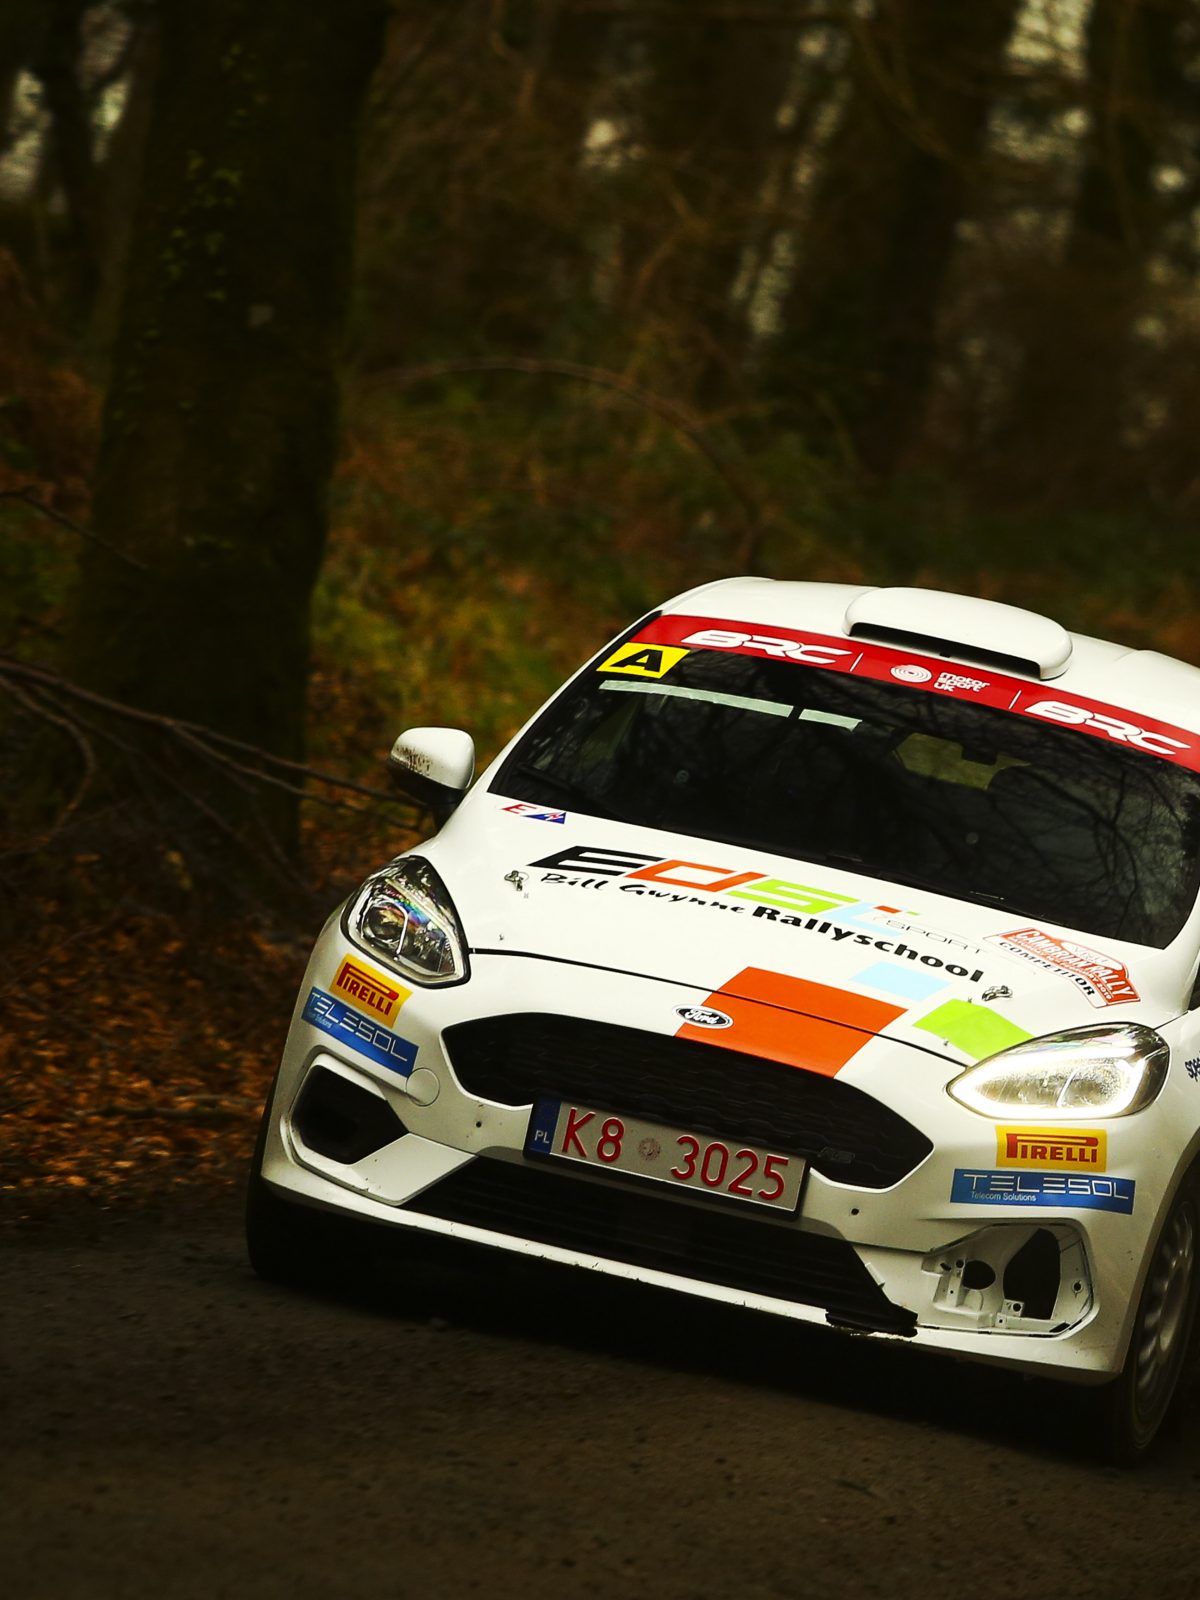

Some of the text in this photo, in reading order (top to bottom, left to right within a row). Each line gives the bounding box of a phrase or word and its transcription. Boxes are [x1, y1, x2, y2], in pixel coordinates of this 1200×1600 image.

[610, 648, 663, 673] A
[681, 629, 852, 664] BRC
[1024, 700, 1191, 755] BRC
[540, 872, 610, 891] Bill
[618, 883, 747, 915] Gwynne
[752, 905, 984, 983] Rallyschool
[999, 941, 1096, 996] COMPETITOR
[336, 961, 399, 1016] PIRELLI
[311, 991, 408, 1062] TELESOL
[684, 1008, 720, 1024] Ford
[534, 1129, 549, 1144] PL
[562, 1107, 789, 1200] K8 3025
[1006, 1133, 1099, 1163] PIRELLI
[963, 1174, 1129, 1200] TELESOL
[971, 1191, 1037, 1202] Telecom Solutions
